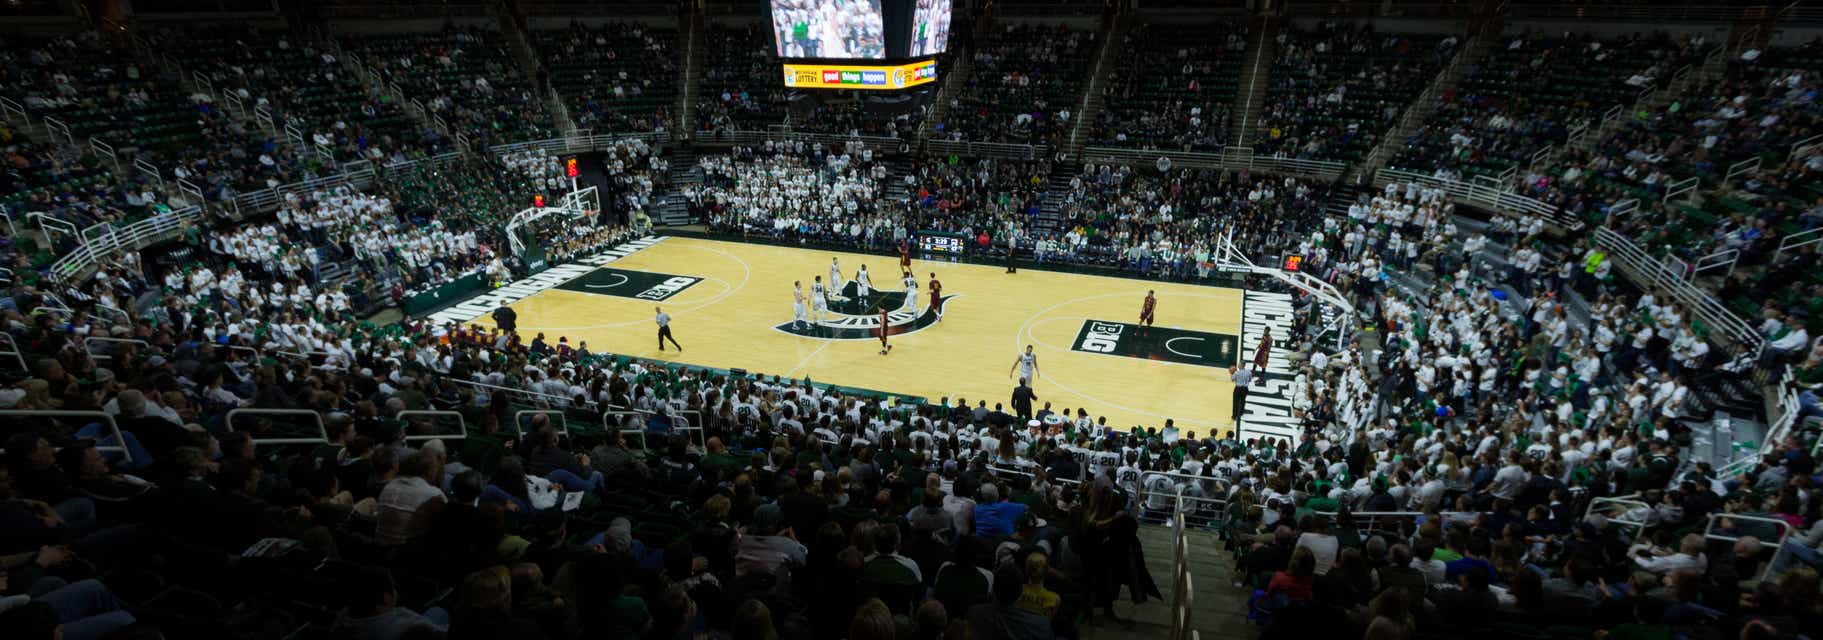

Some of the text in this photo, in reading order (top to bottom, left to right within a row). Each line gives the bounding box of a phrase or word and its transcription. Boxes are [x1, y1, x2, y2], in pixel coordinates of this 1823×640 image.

[824, 72, 884, 82] good things happen
[427, 264, 598, 326] MICHIGAN
[1100, 456, 1115, 467] 20
[1122, 470, 1137, 482] 20
